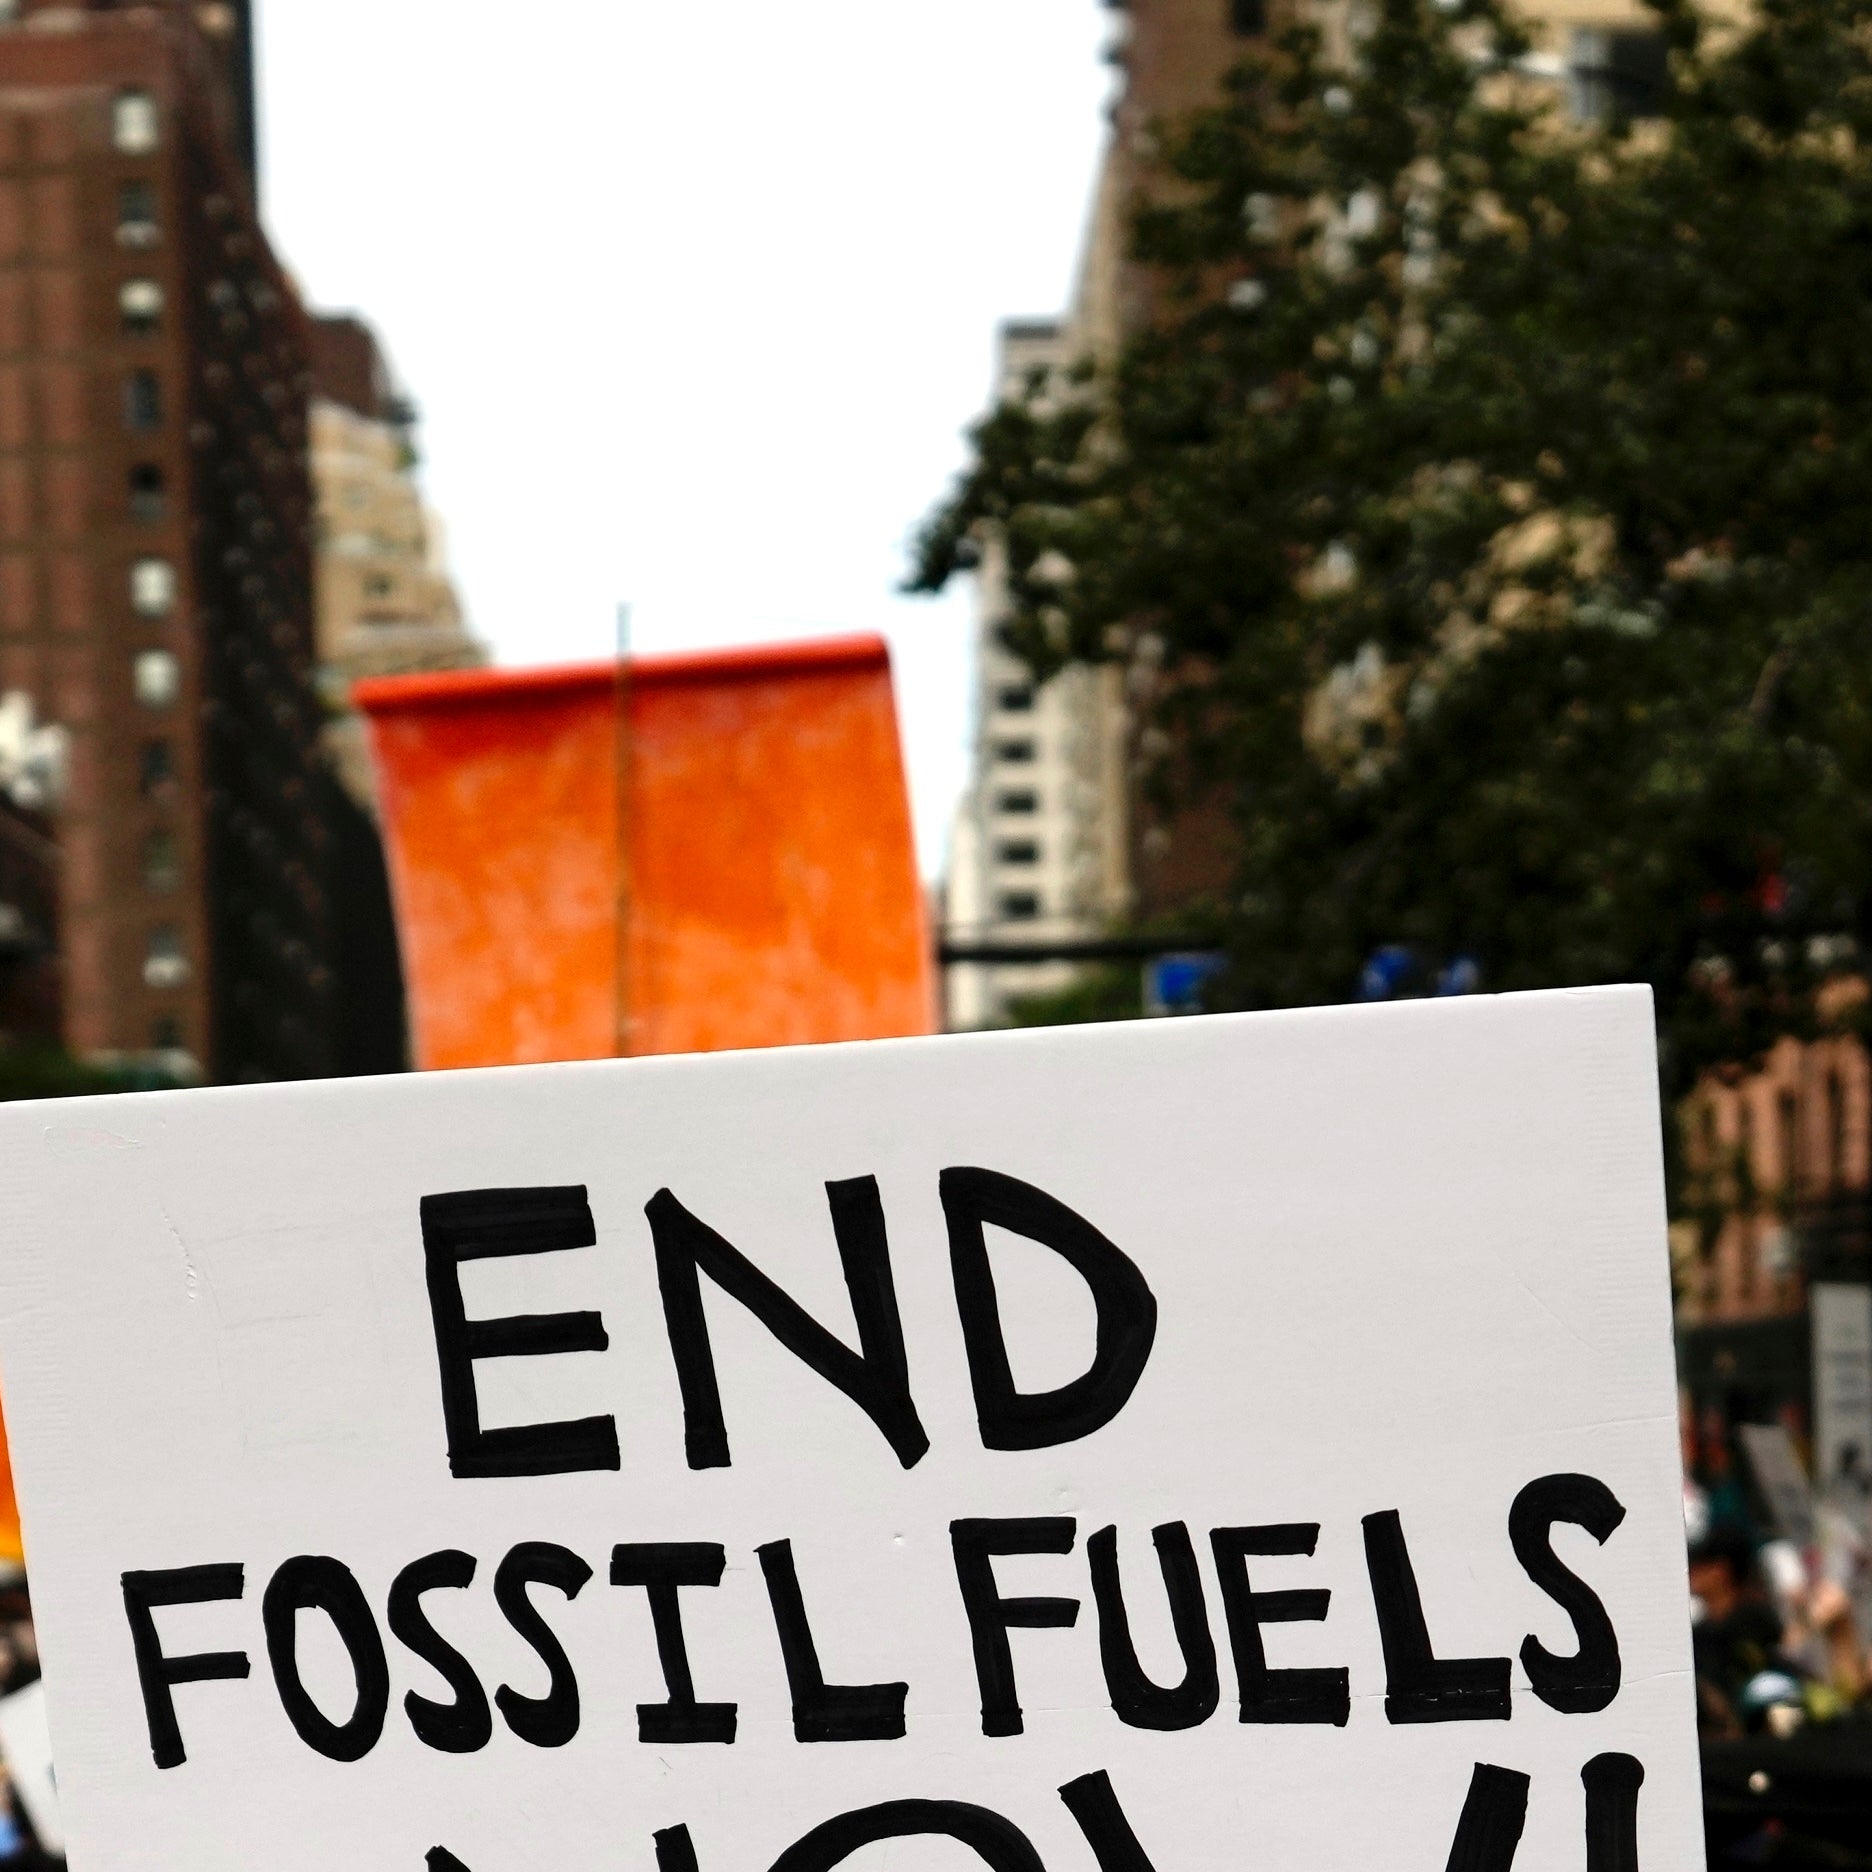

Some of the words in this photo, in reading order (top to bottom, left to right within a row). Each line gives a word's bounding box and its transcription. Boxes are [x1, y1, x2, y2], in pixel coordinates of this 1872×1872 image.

[420, 1166, 1158, 1478] END
[121, 1539, 909, 1769] FOSSIL
[949, 1473, 1626, 1737] FUELS
